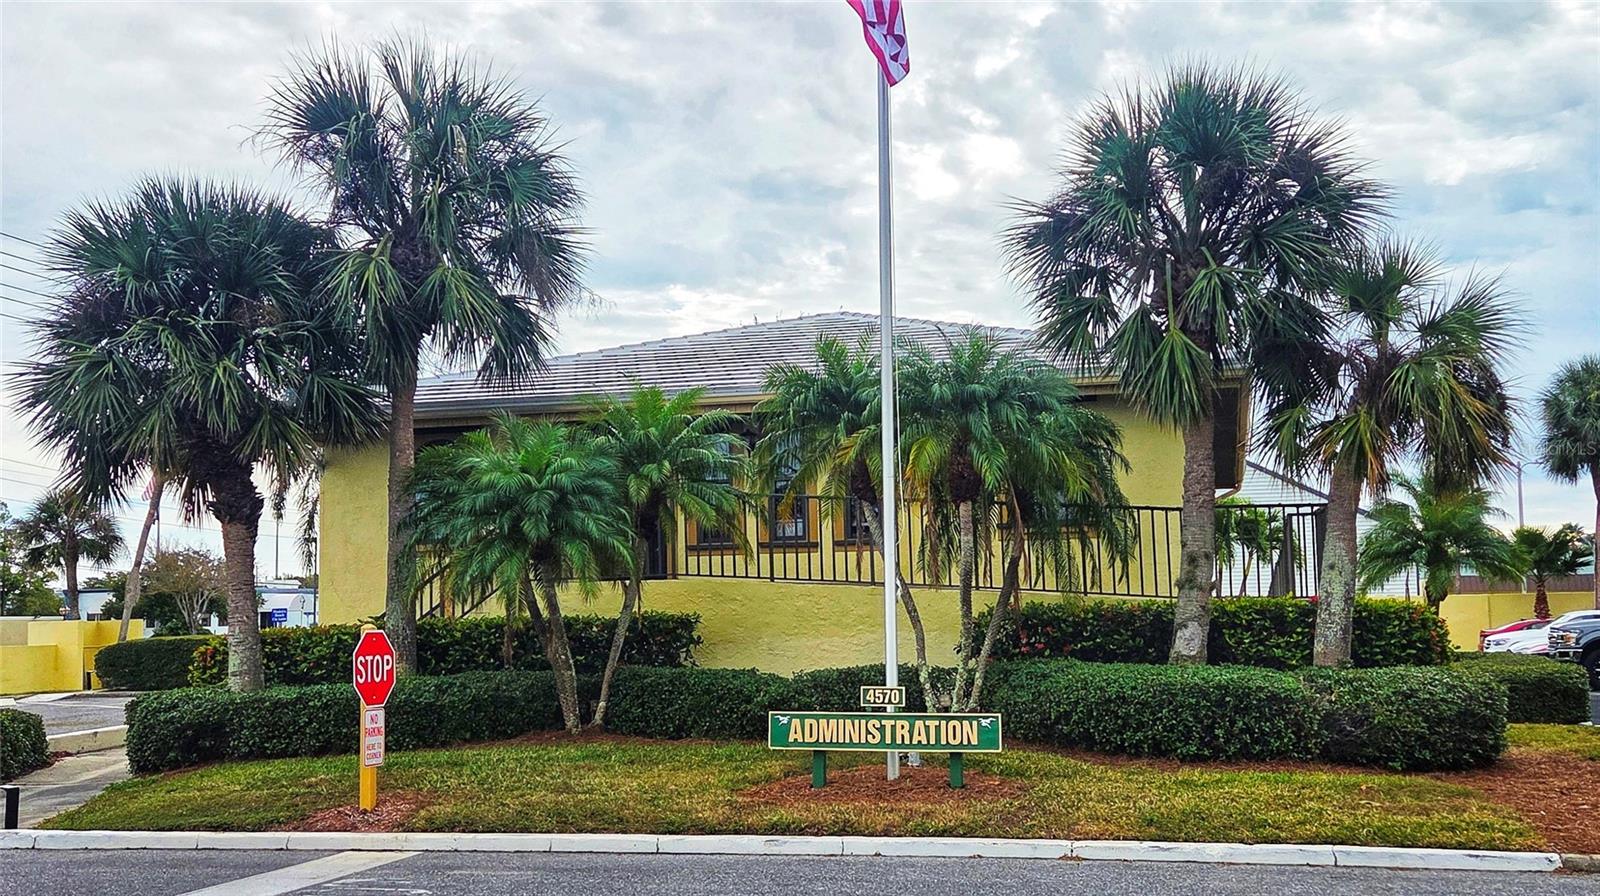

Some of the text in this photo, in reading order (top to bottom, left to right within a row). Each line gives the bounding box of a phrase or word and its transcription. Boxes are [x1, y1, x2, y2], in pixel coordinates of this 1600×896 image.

[357, 655, 392, 684] STOP
[866, 689, 899, 704] 4570
[370, 713, 379, 724] NO
[365, 726, 383, 737] PARKING
[788, 718, 978, 746] ADMINISTRATION
